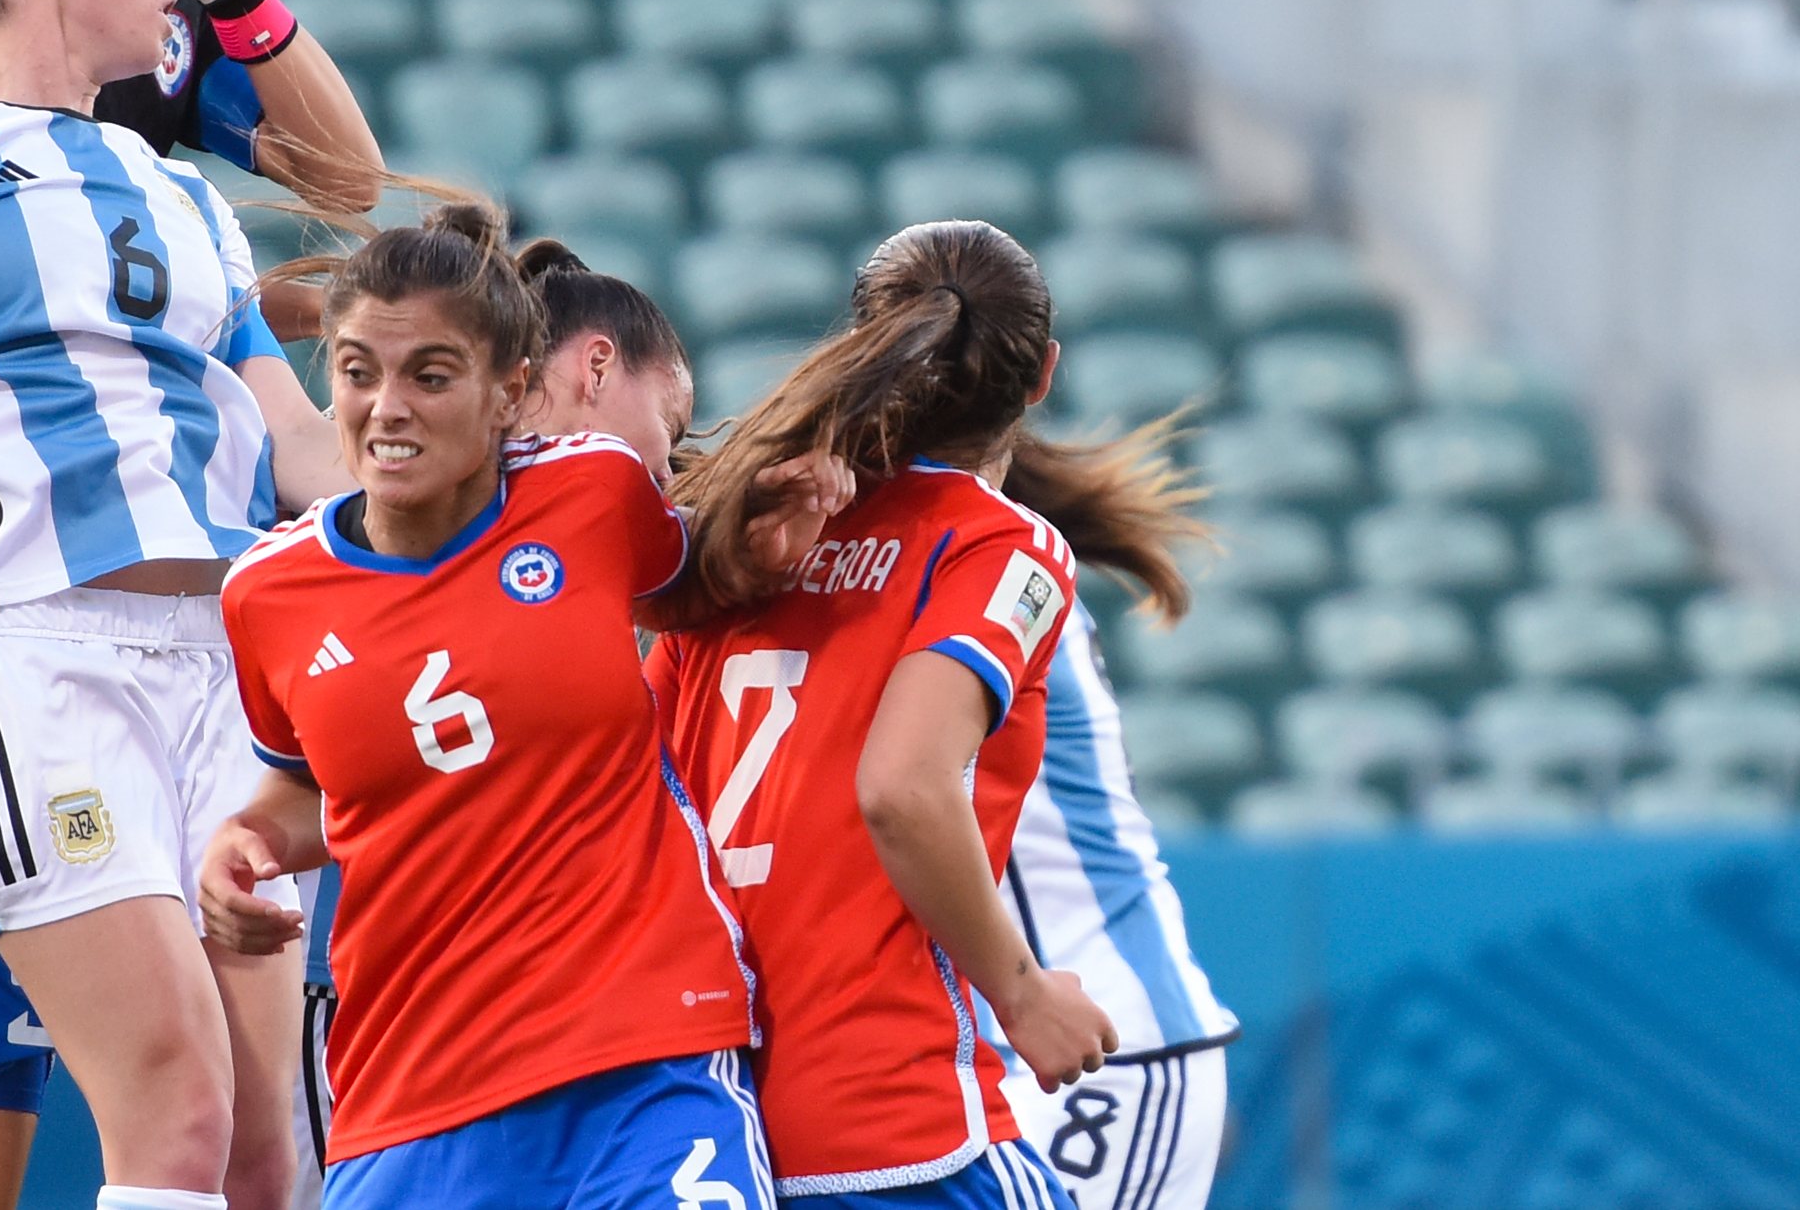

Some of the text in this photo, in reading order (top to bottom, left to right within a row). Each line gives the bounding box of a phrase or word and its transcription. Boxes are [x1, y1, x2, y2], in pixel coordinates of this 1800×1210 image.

[109, 216, 168, 320] 6
[780, 537, 901, 594] UEROA
[404, 649, 495, 774] 6
[707, 649, 809, 888] 2
[67, 809, 100, 840] AFA
[671, 1137, 747, 1210] 6
[1048, 1086, 1120, 1180] 8
